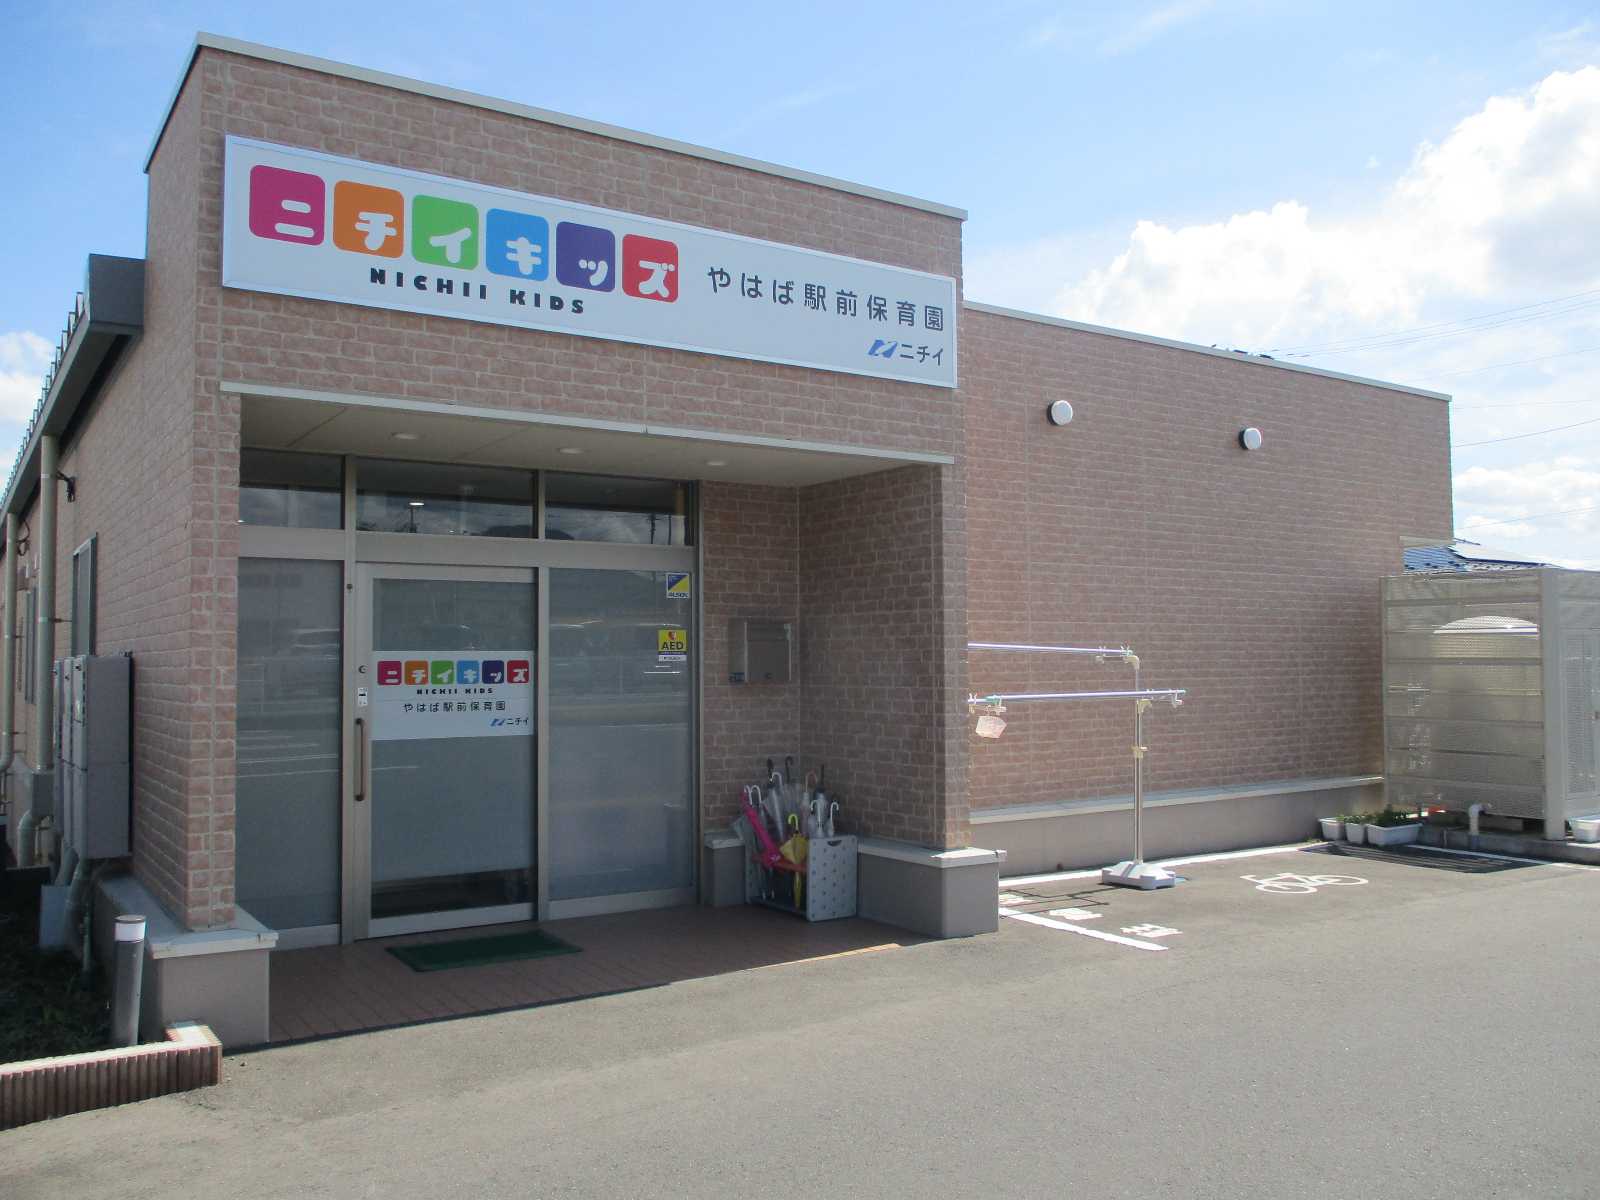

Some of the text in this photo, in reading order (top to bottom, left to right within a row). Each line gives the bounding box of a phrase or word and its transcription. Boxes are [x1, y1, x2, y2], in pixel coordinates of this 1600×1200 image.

[273, 198, 677, 299] ニチイキッズ
[369, 267, 584, 314] NICHII KIDS
[707, 266, 944, 332] やはば駅前保育園
[899, 343, 944, 366] ニチイ
[661, 641, 684, 650] AED
[384, 667, 529, 684] ニチイキッズ
[403, 700, 506, 713] やはば駅前保育園
[506, 717, 529, 726] ニチイ
